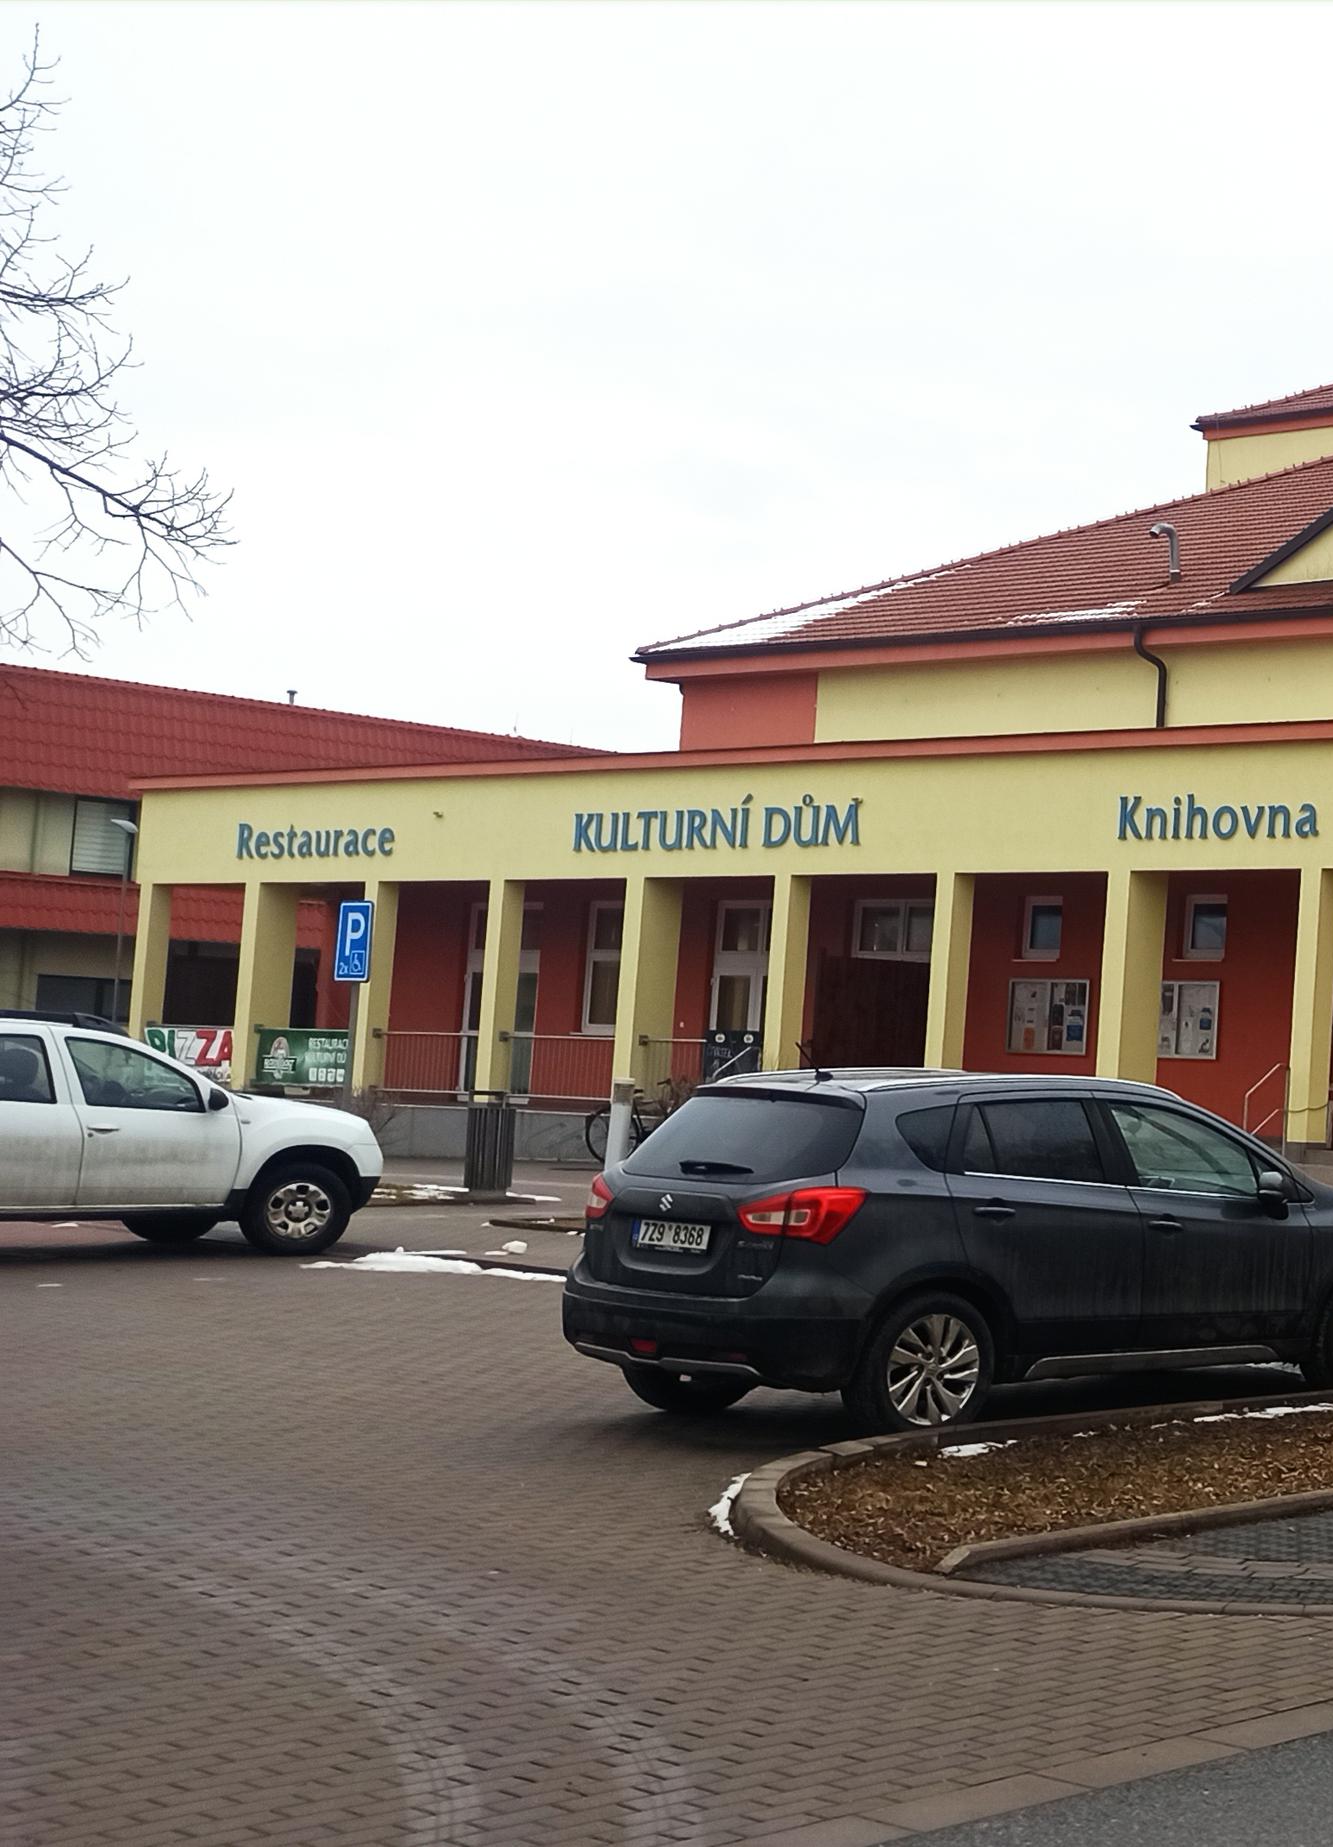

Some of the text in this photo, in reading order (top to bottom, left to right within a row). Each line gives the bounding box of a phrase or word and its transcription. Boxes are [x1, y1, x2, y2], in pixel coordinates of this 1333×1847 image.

[572, 792, 862, 853] KULTURNÍ DŮM
[1117, 793, 1319, 841] Knihovna
[236, 822, 396, 860] Restaurace
[345, 912, 366, 956] P
[308, 1037, 349, 1050] RESTAURAC
[672, 1224, 705, 1247] 8368
